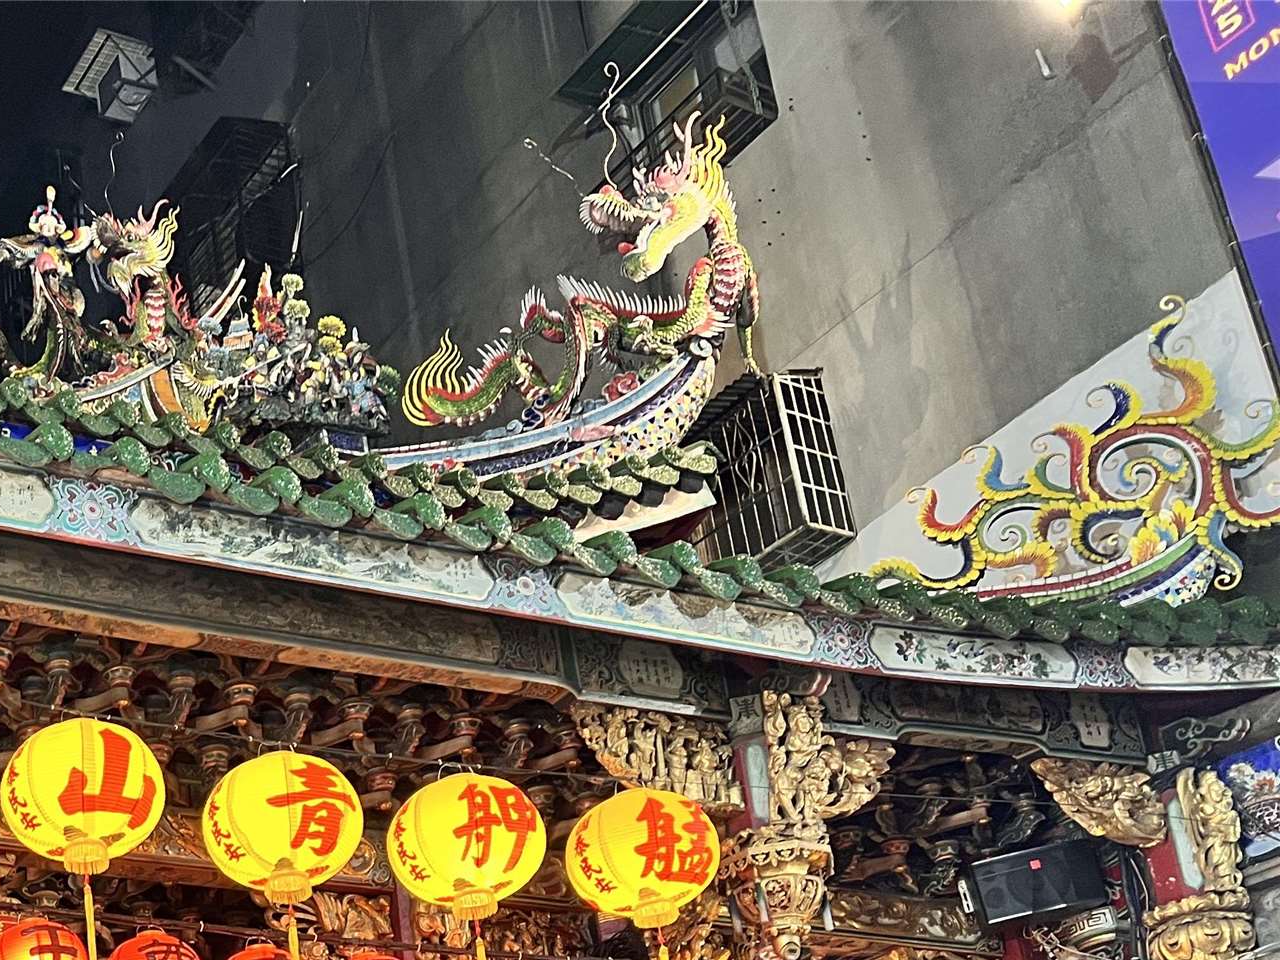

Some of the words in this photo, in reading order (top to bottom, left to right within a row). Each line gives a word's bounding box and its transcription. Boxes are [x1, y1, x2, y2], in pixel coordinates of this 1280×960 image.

[58, 728, 157, 830] 山
[266, 762, 356, 856] 青
[453, 784, 537, 873] 舺
[634, 797, 713, 886] 艋
